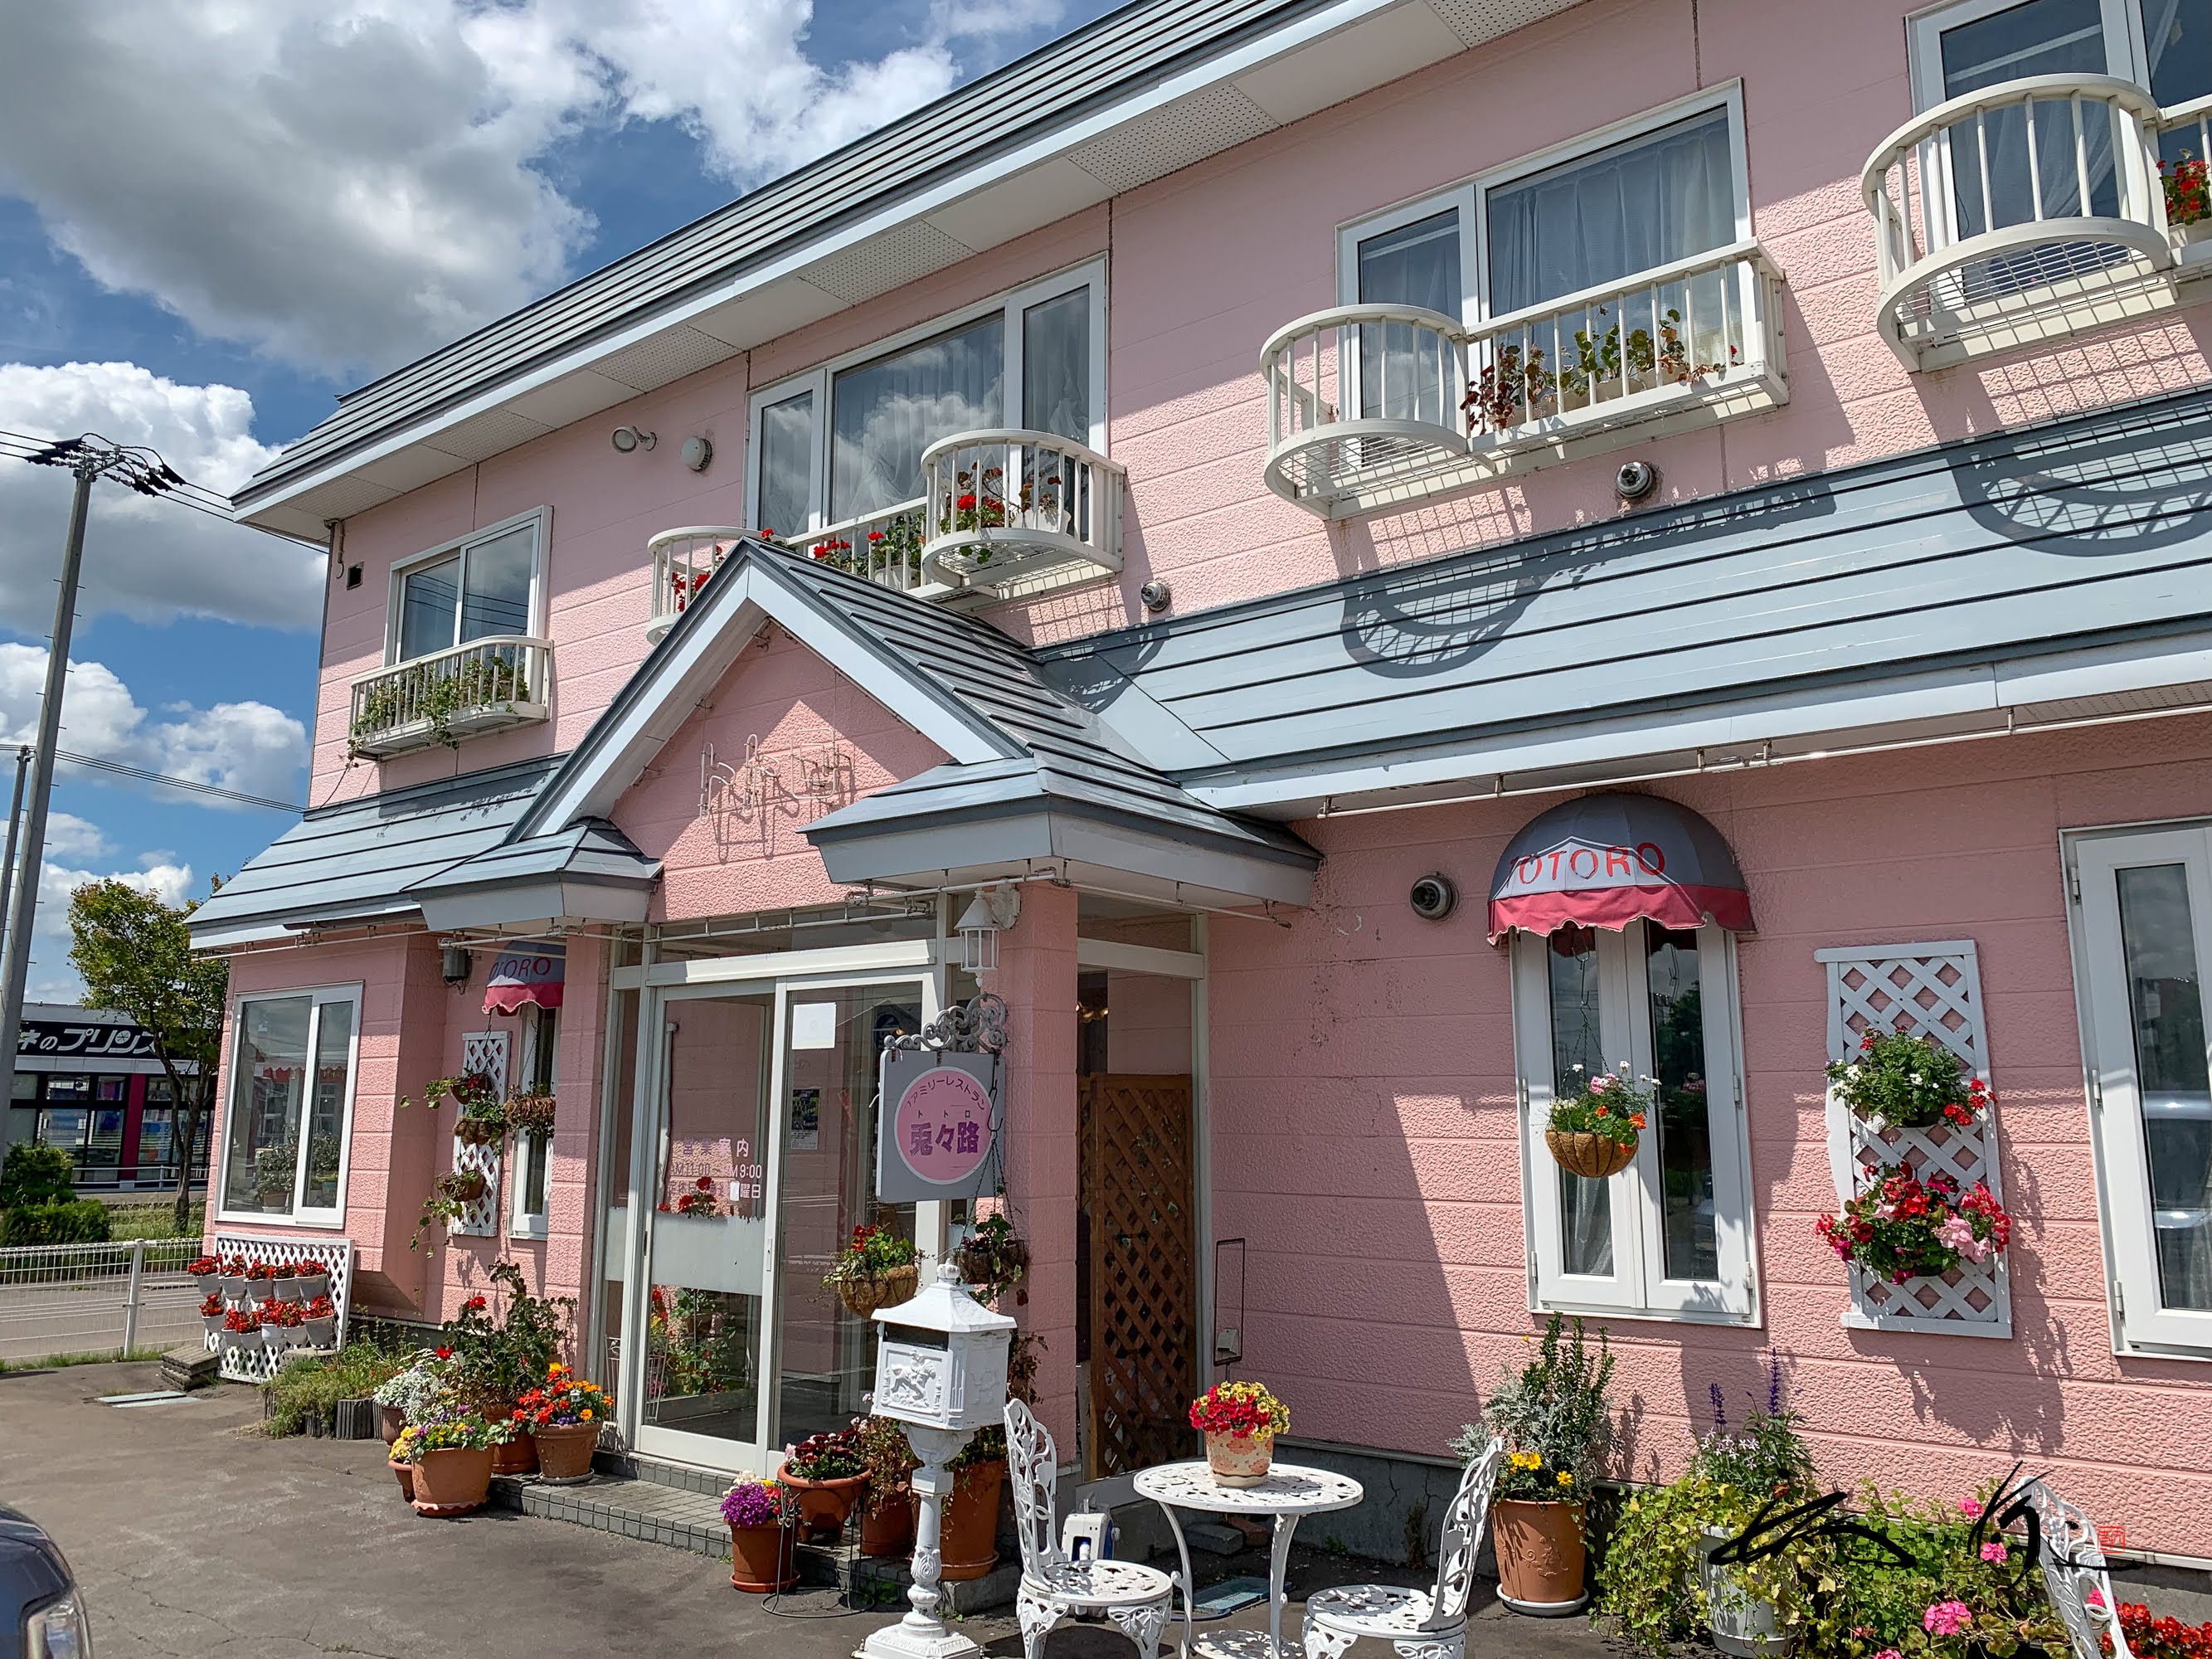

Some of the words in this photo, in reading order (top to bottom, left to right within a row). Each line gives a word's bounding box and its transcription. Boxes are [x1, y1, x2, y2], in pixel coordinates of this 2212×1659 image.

[1506, 842, 1665, 888] TOTORO
[904, 1075, 985, 1110] ファミリーレストラン
[917, 1110, 971, 1118] トトロ
[683, 1137, 749, 1158] 営業案内
